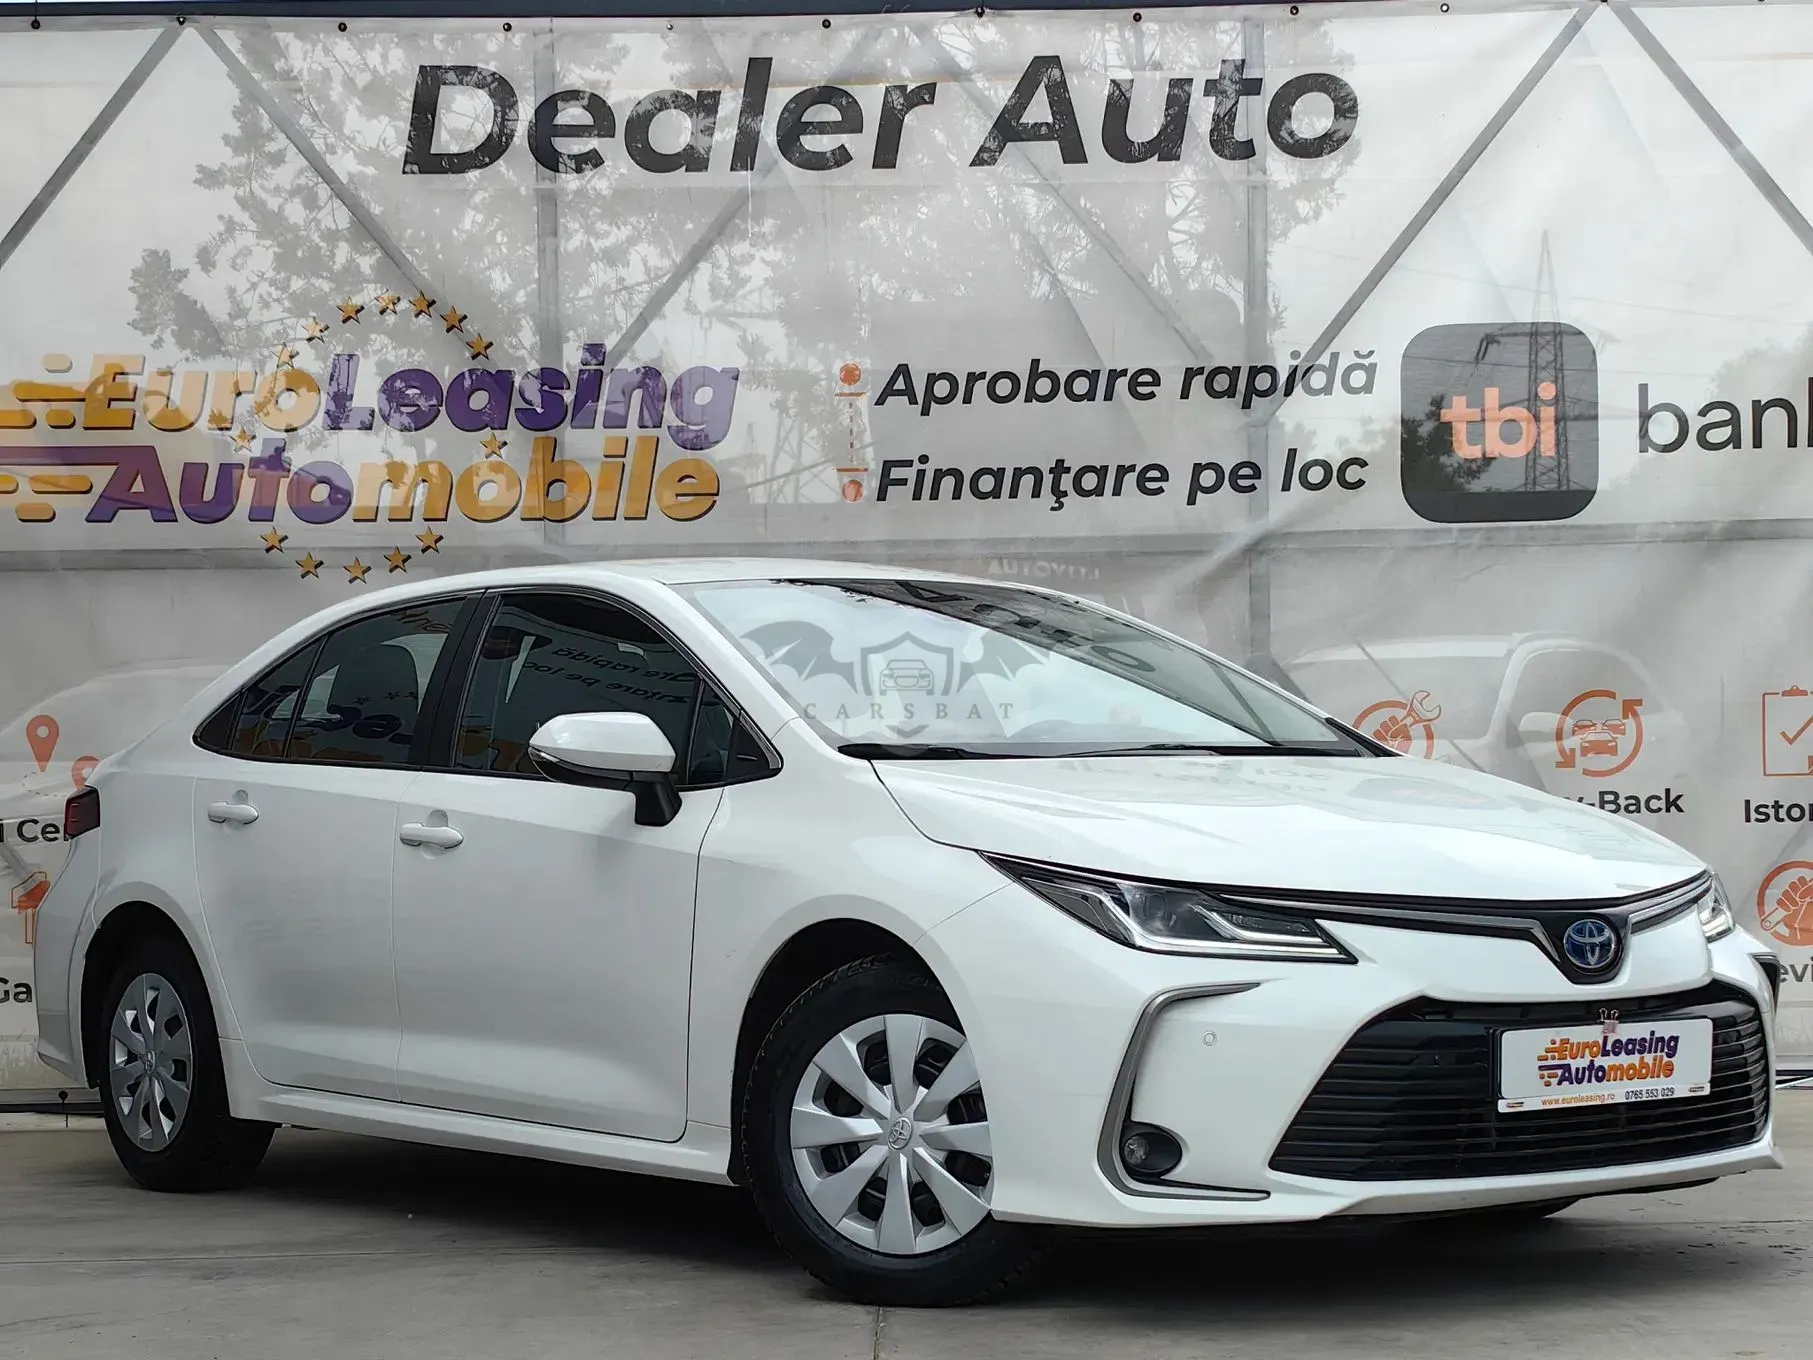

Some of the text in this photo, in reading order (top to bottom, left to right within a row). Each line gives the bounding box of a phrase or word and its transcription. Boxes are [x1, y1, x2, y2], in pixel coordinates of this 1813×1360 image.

[402, 55, 1359, 175] Dealer Auto
[83, 343, 740, 450] EuroLeasing
[874, 349, 1378, 417] Aprobare rapidă
[1440, 376, 1813, 460] tbi ban
[85, 435, 721, 523] Automobile
[1186, 460, 1263, 506] pe
[1281, 448, 1369, 493] loc
[1556, 1030, 1680, 1059] EuroLeasing
[1556, 1055, 1675, 1086] Automobile
[1541, 1086, 1675, 1106] www.euroleasing.ro 0765 553 029
